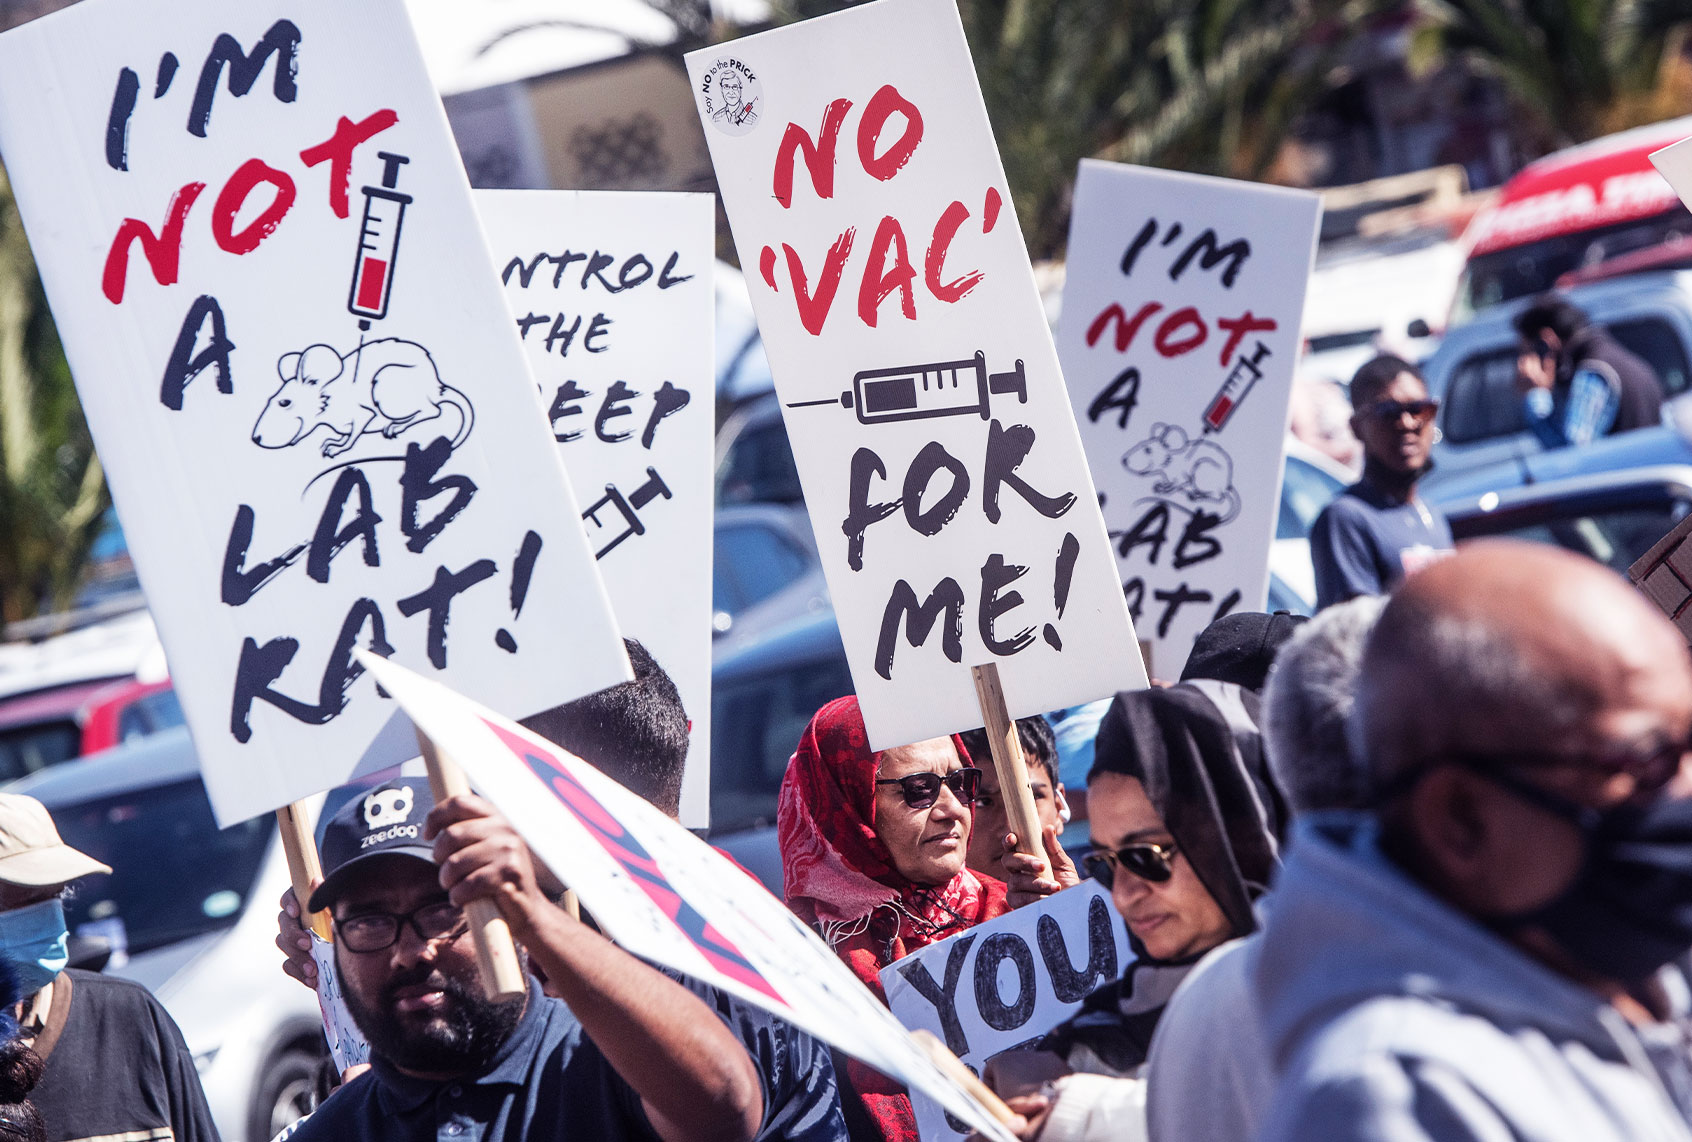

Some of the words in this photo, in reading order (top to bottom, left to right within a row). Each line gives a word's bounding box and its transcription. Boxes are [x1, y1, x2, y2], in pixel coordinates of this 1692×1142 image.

[106, 19, 301, 171] I'M
[702, 74, 712, 93] NO
[710, 66, 718, 76] to
[717, 60, 728, 70] the
[730, 59, 756, 83] PRICK
[705, 96, 713, 114] Say
[773, 84, 925, 209] NO
[102, 109, 399, 304] NOT
[759, 186, 1004, 336] 'VAC'
[1120, 216, 1253, 290] I'M
[160, 294, 235, 410] A
[516, 311, 615, 357] THE
[1085, 300, 1279, 368] NOT
[537, 380, 691, 449] EEP
[1087, 366, 1141, 430] A
[221, 436, 478, 605] LAB
[841, 418, 1078, 572] FOR
[1097, 491, 1223, 569] AB
[231, 530, 542, 743] RAT!
[874, 532, 1080, 681] ME!
[897, 894, 1118, 1057] YOU
